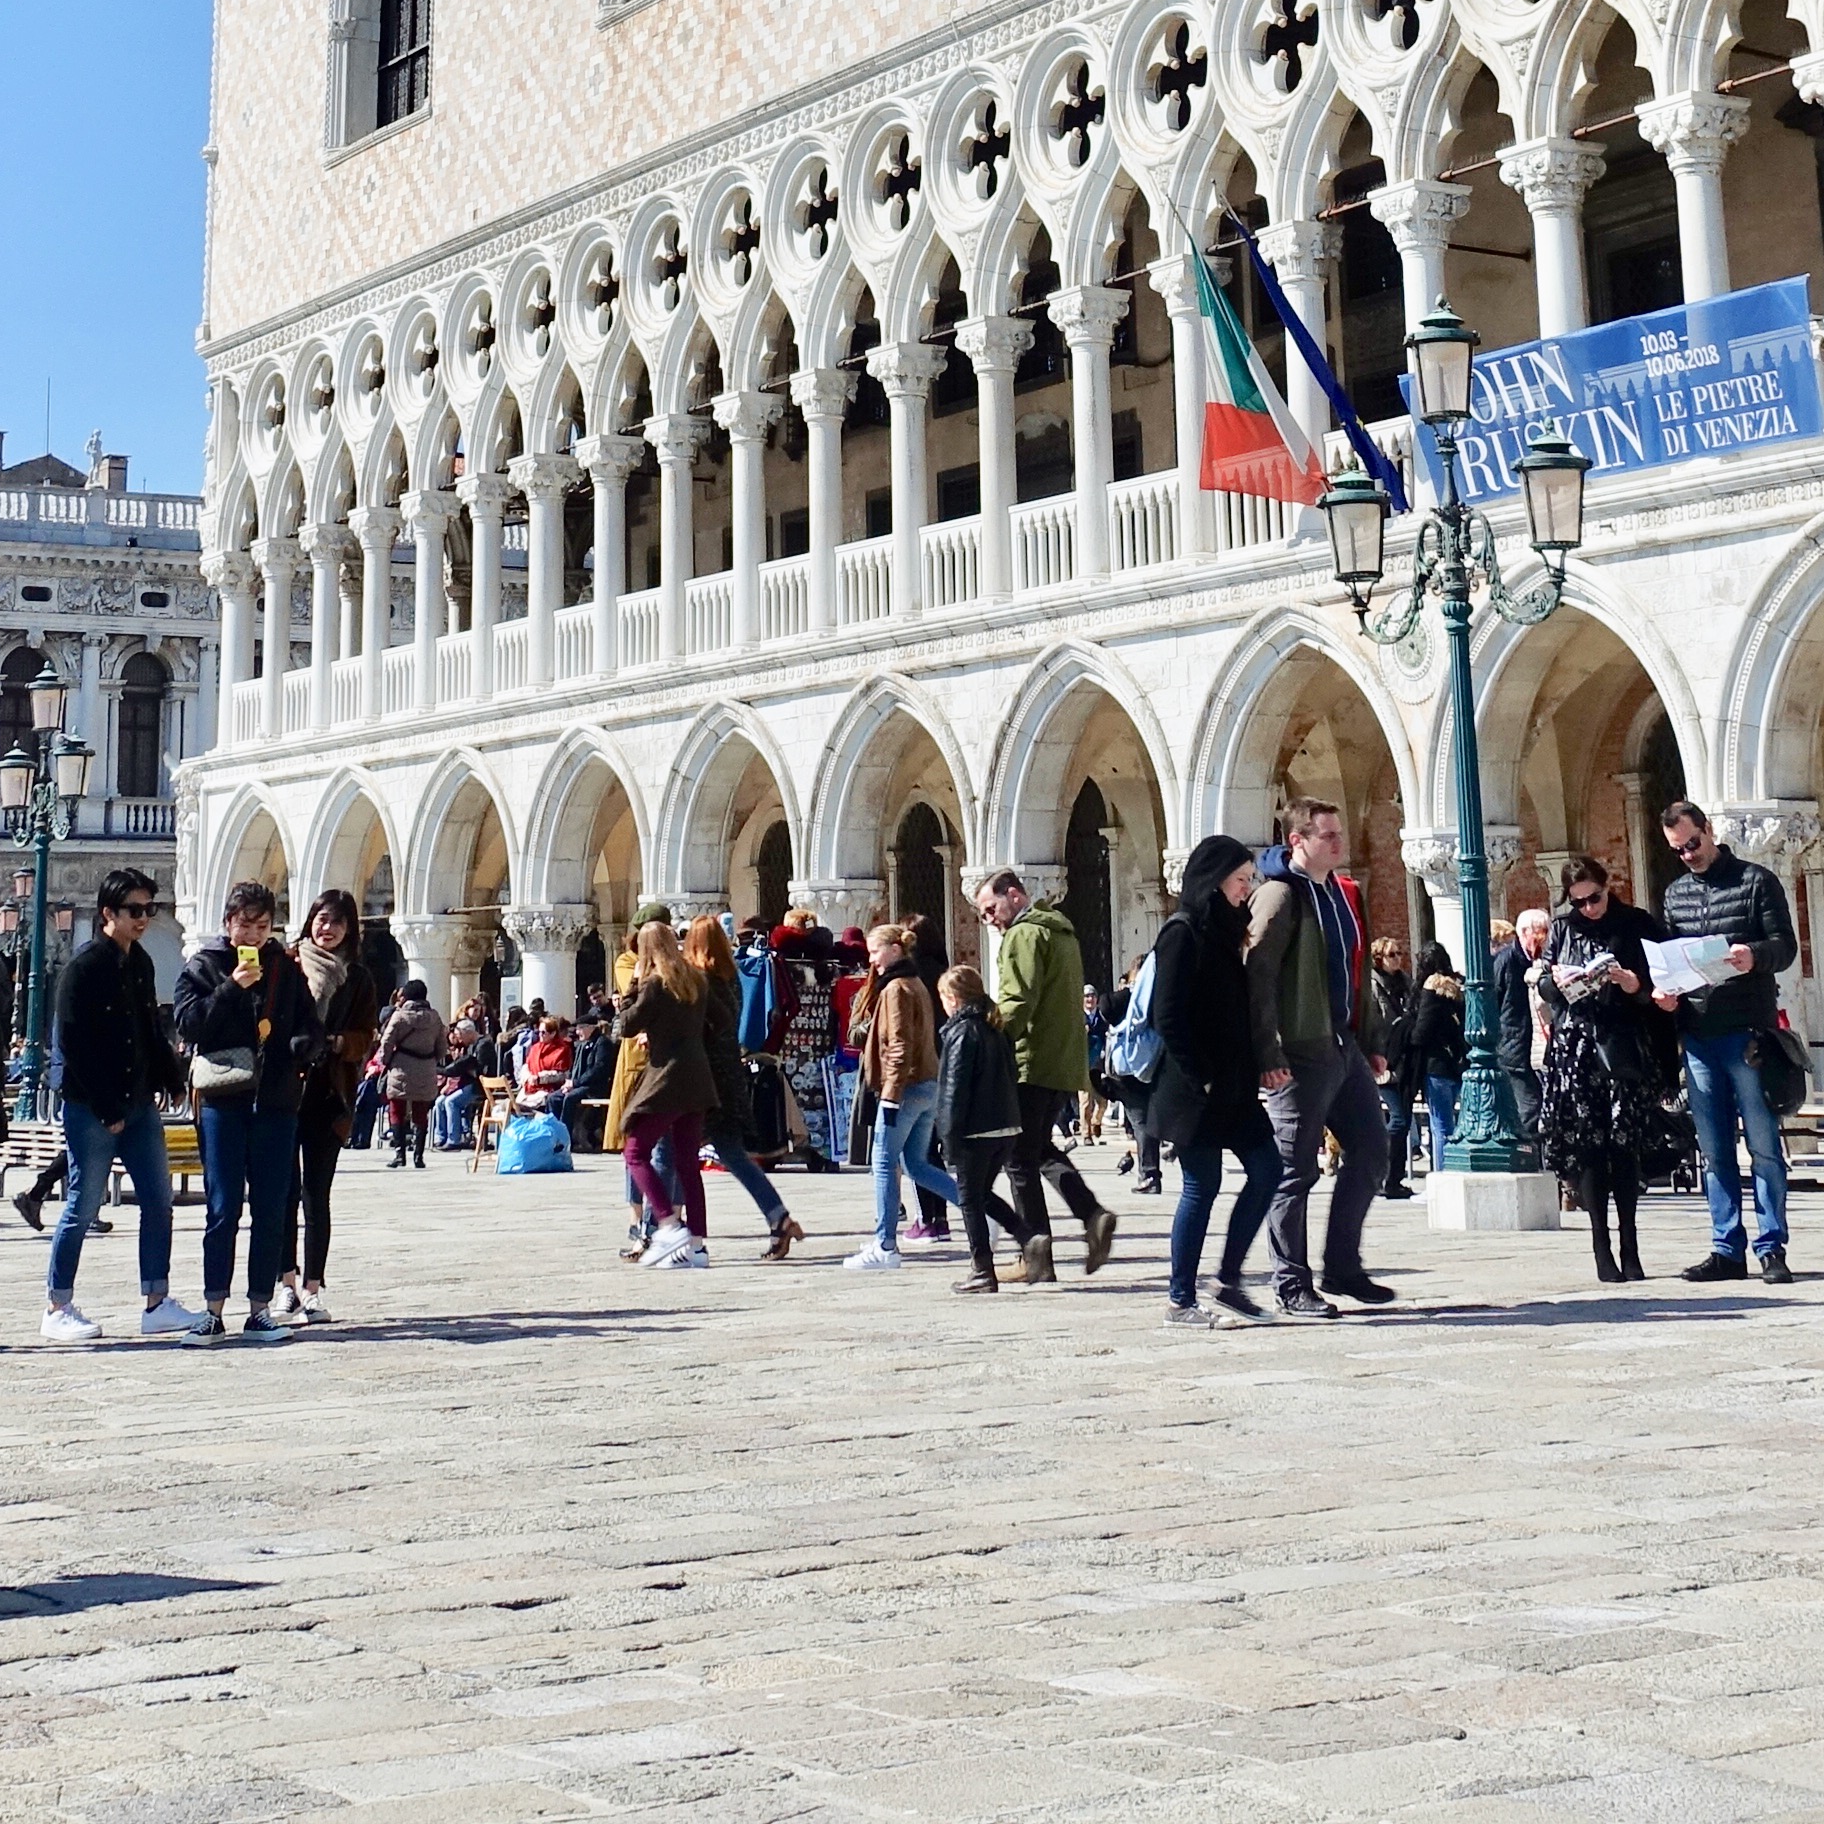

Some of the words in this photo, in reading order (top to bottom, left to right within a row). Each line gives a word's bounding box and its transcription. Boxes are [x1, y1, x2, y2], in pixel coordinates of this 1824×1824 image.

[1640, 330, 1678, 356] 10.03
[1645, 344, 1720, 378] 10.06.2018
[1447, 345, 1574, 437] OHN
[1653, 390, 1688, 423] LE
[1690, 370, 1784, 416] PIETRE
[1662, 425, 1691, 457] DI
[1692, 404, 1799, 450] VENEZIA
